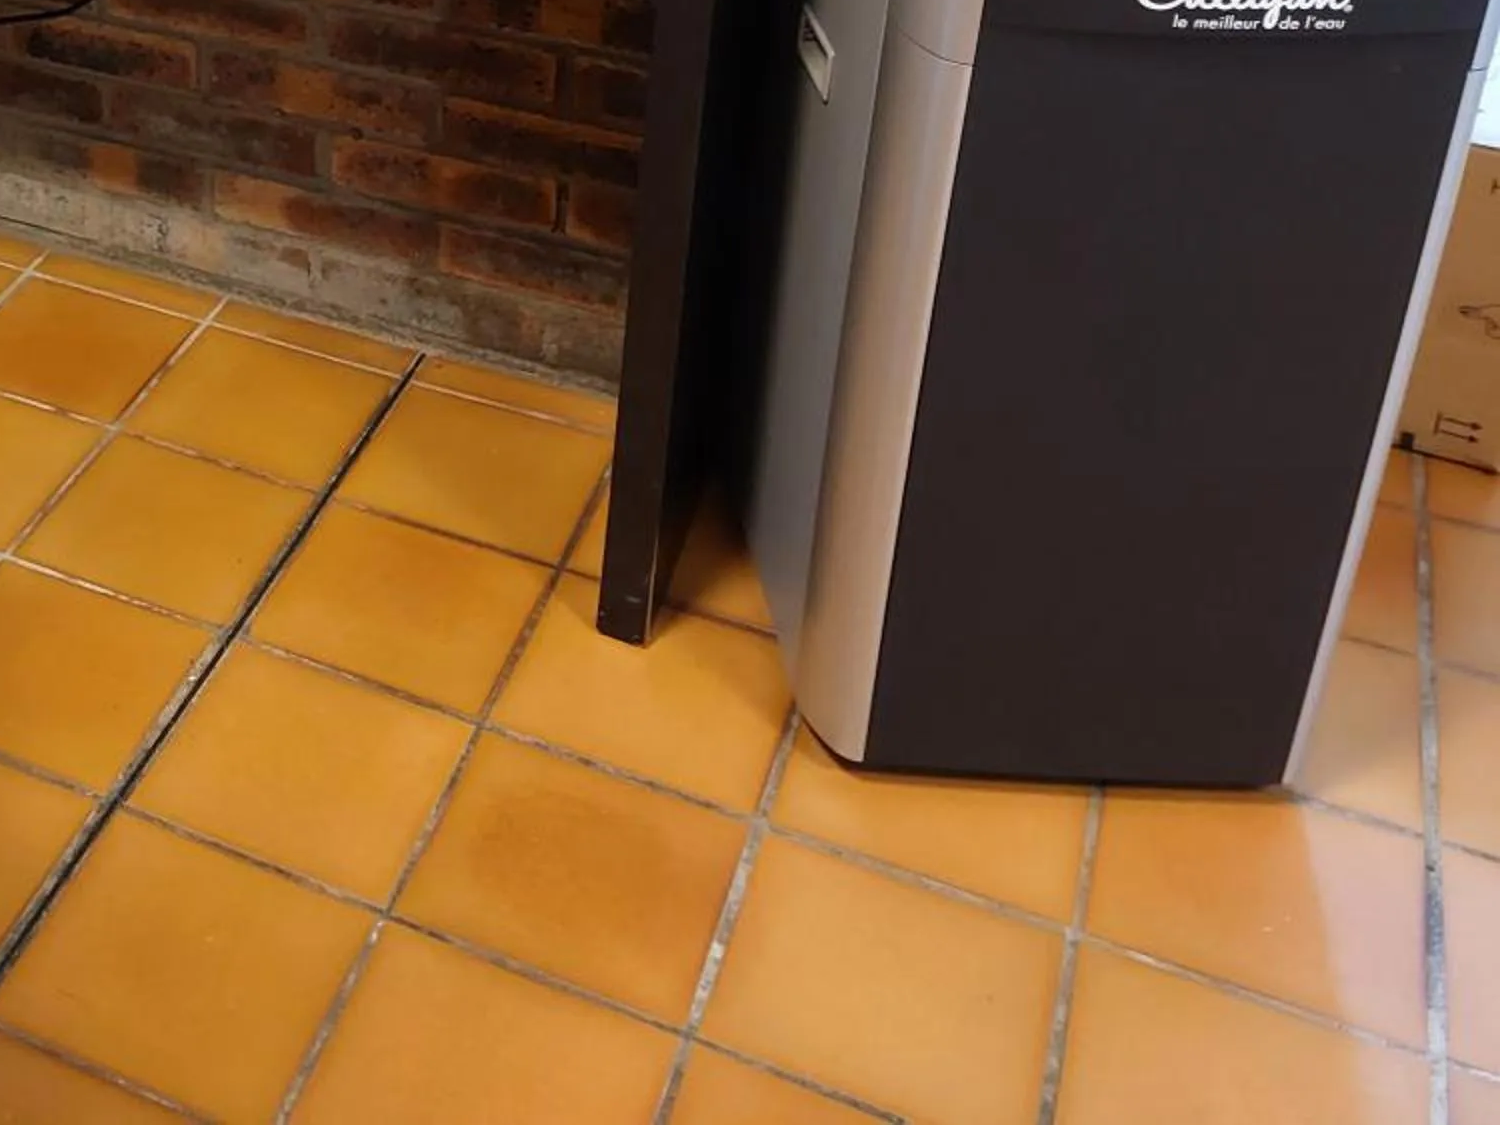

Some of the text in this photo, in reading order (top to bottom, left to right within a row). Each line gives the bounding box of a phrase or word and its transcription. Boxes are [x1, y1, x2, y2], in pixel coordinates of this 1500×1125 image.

[1172, 14, 1347, 30] le meilleur de l'eau
